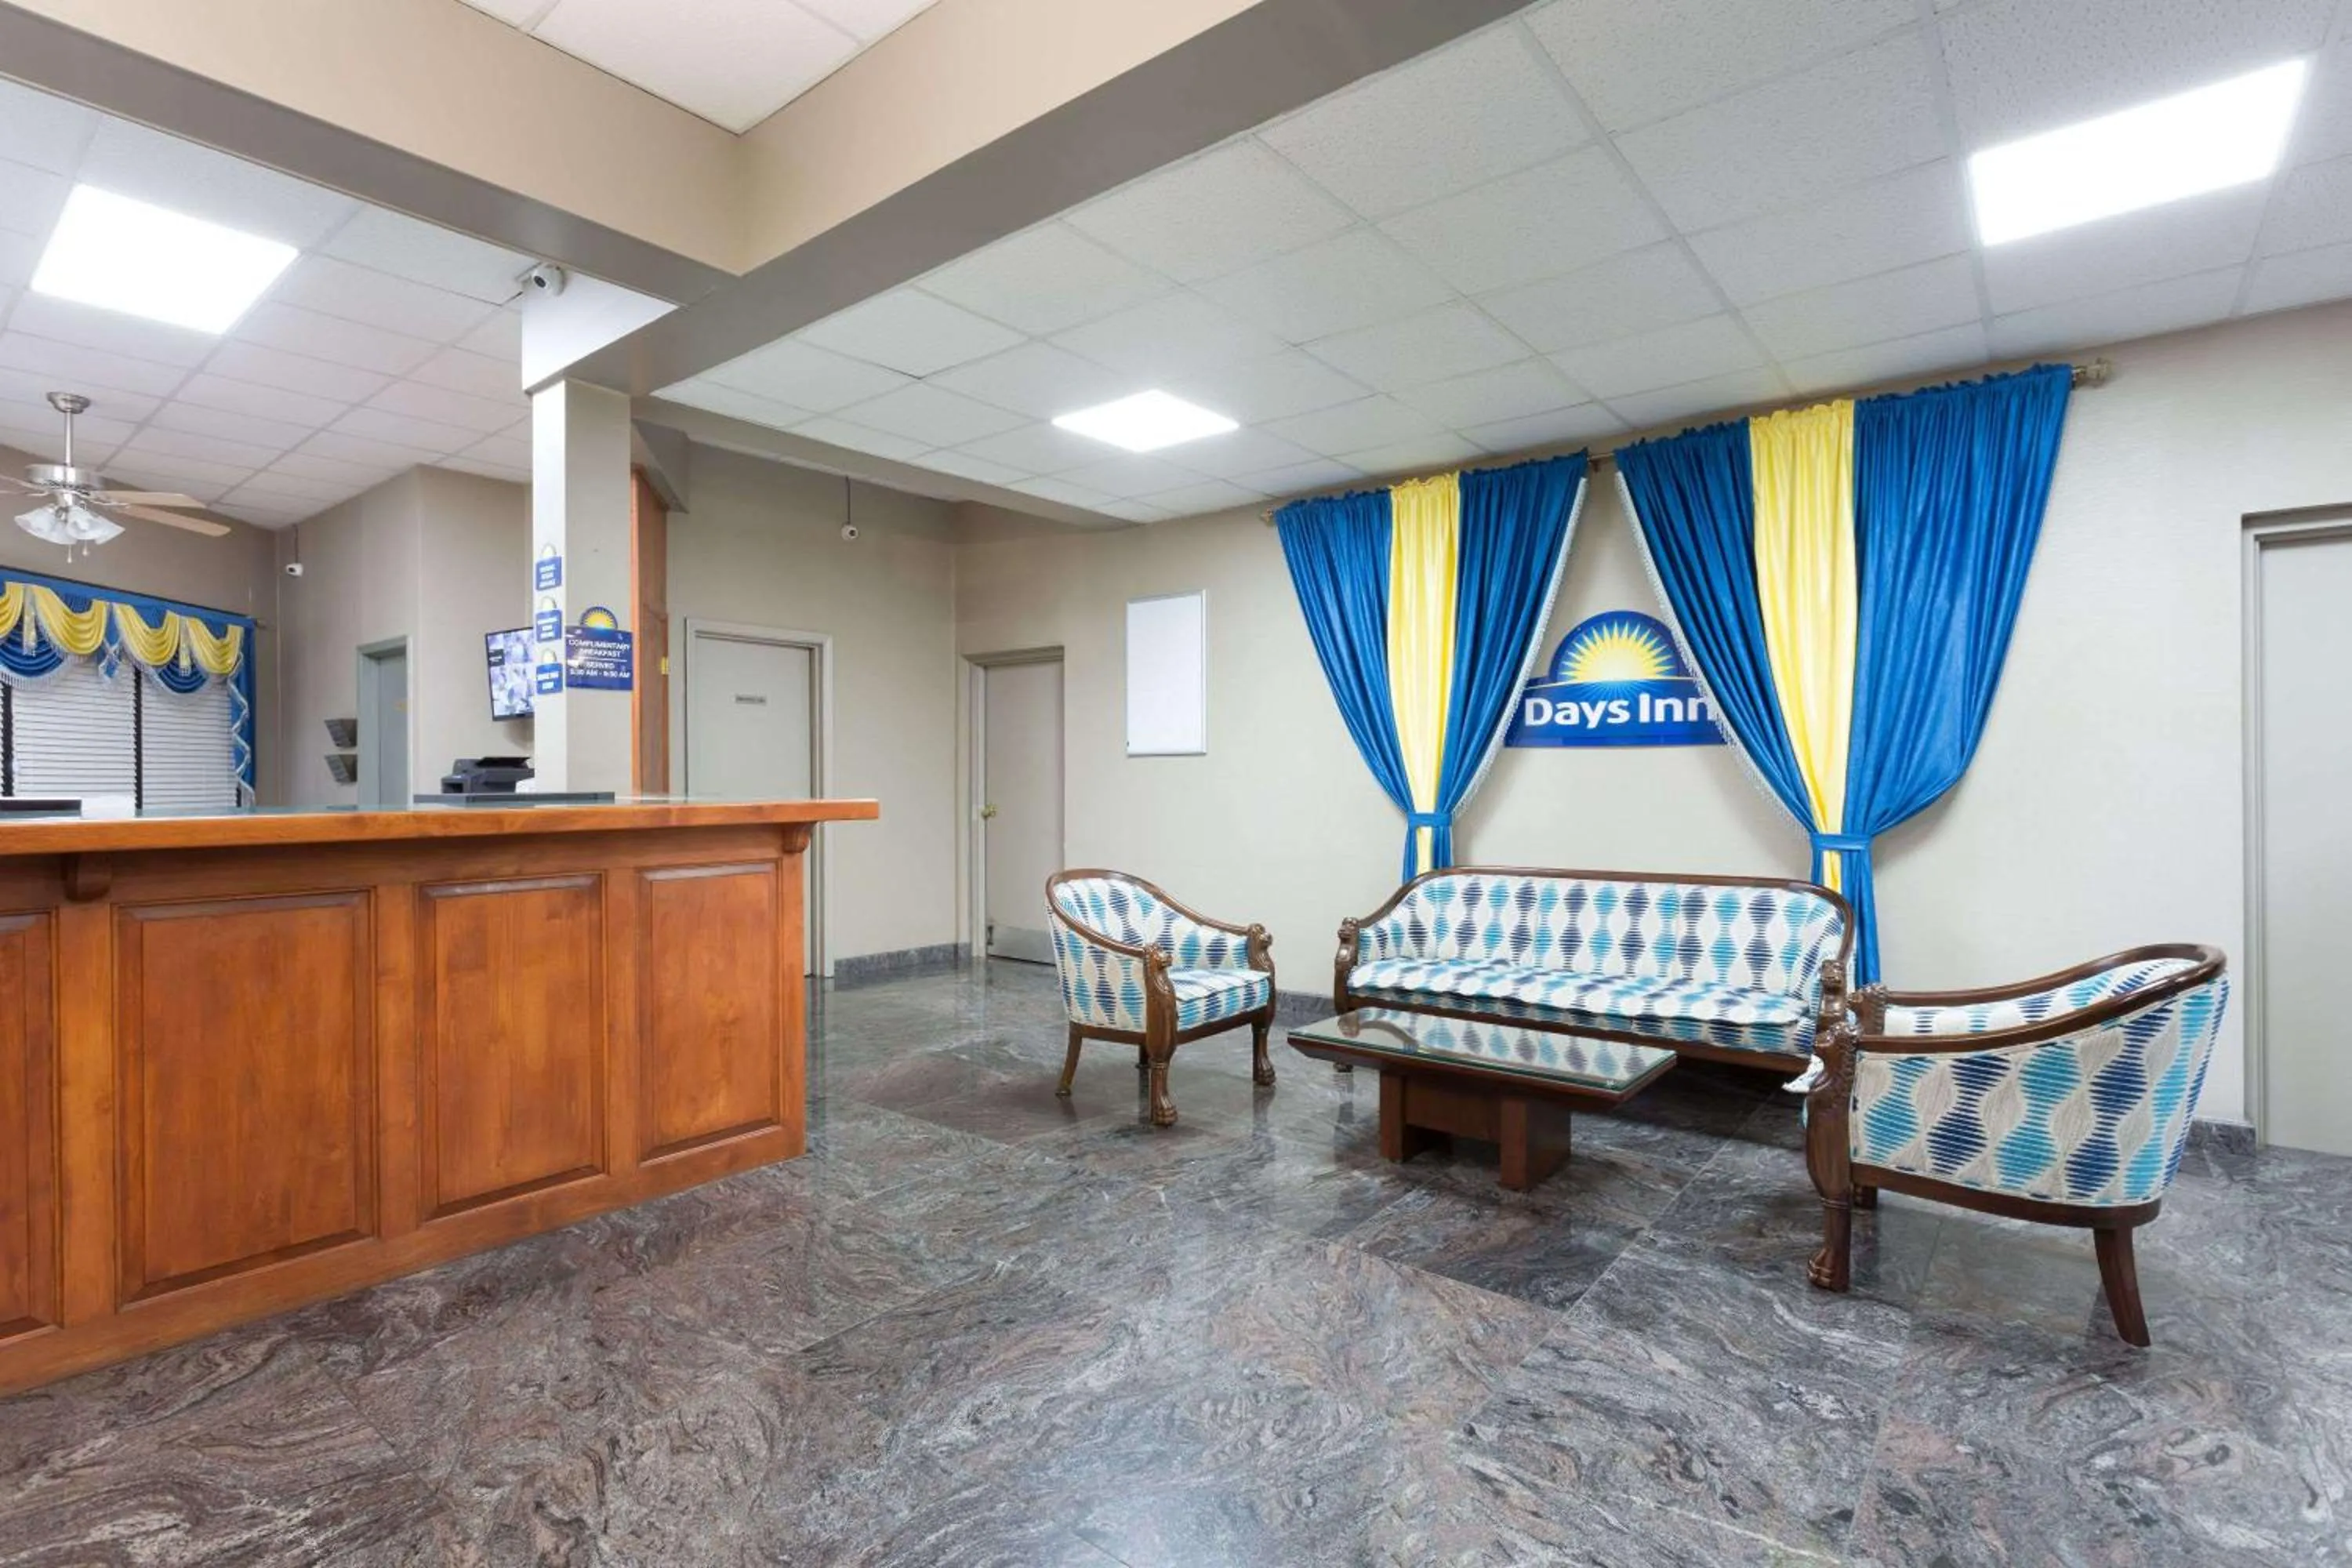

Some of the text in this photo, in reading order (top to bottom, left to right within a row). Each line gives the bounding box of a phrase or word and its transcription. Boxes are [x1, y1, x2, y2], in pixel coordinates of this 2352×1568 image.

[568, 639, 630, 650] COMPLIMENTARY
[579, 648, 622, 657] BREAKFAST
[1525, 692, 1715, 729] Days Inn
